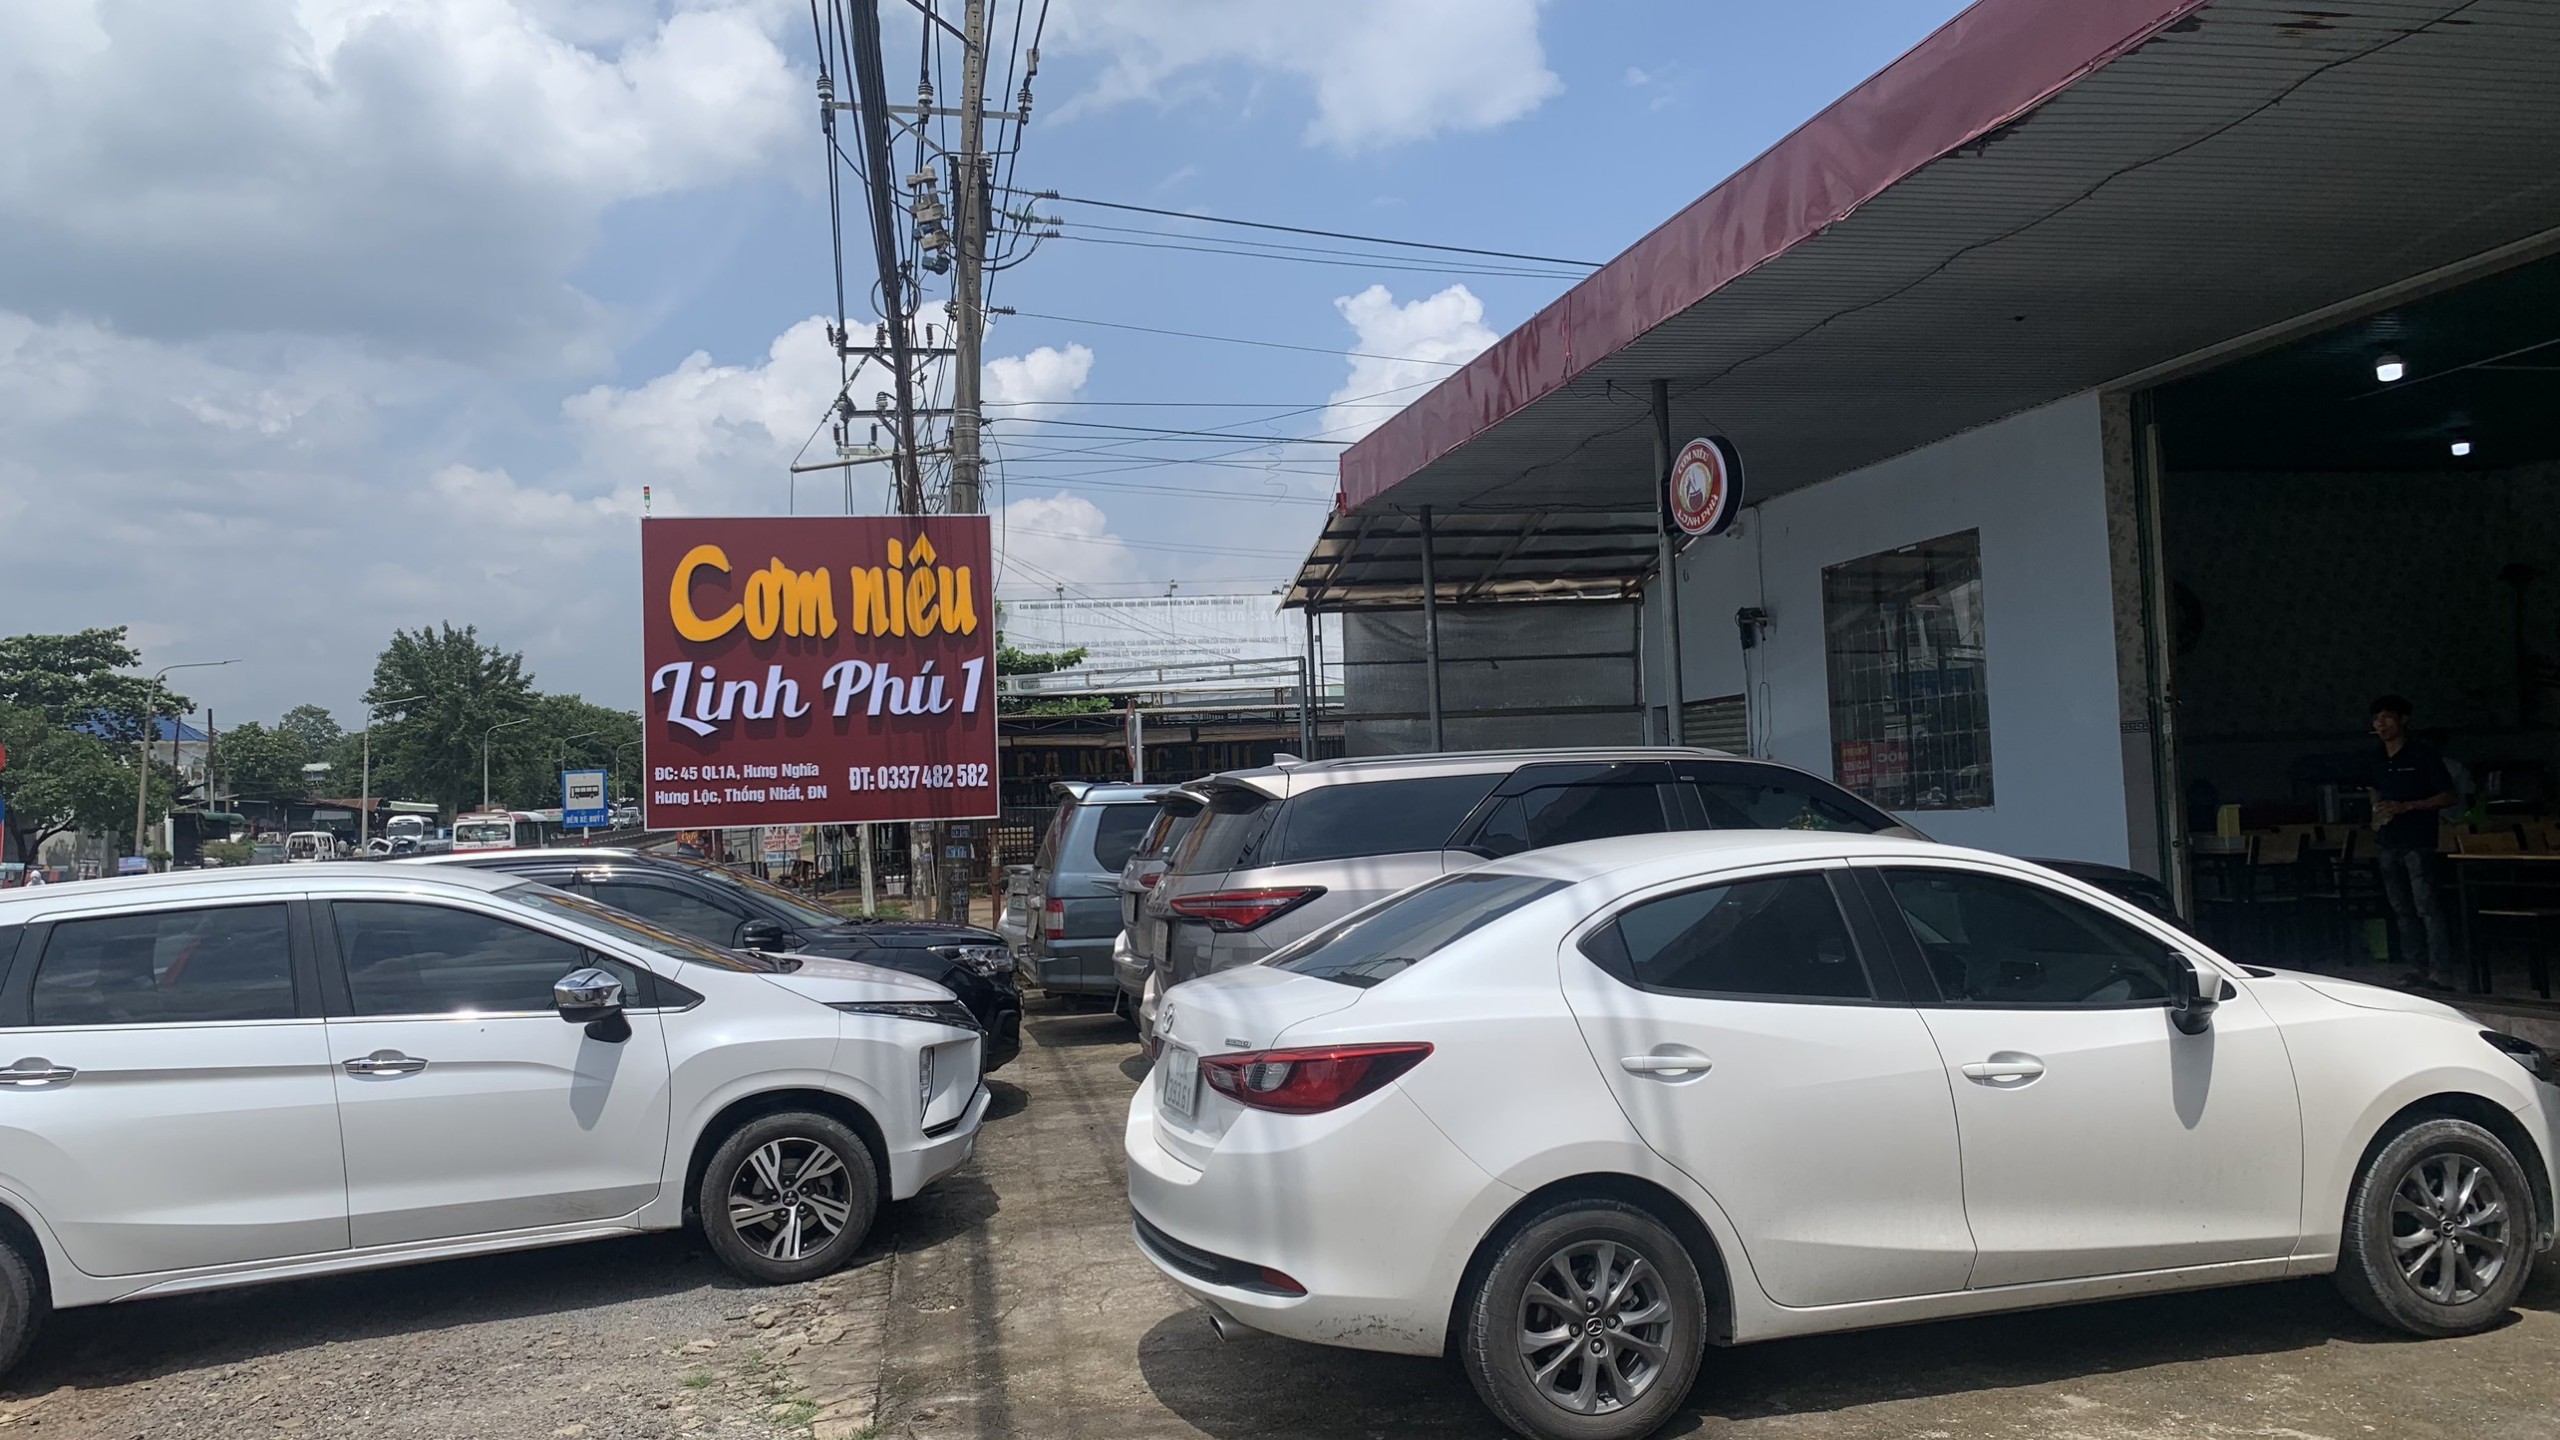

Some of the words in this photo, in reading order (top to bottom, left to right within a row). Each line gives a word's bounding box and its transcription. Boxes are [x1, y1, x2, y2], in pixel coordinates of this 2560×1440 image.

[1677, 452, 1692, 474] CƠM
[1692, 448, 1709, 463] NIÊU
[669, 544, 838, 642] Cơm
[850, 531, 978, 639] niêu
[651, 660, 811, 737] Linh
[822, 658, 954, 718] Phú
[960, 656, 985, 714] 1
[654, 766, 679, 782] ĐC:
[680, 766, 698, 780] 45
[701, 765, 741, 781] QL1A,
[743, 764, 777, 779] Hưng
[781, 763, 820, 779] Nghĩa
[849, 766, 875, 791] ĐT:
[877, 765, 920, 790] 0337
[921, 764, 954, 788] 482
[956, 763, 989, 788] 582
[655, 790, 689, 806] Hưng
[693, 788, 722, 806] Lộc,
[724, 785, 765, 803] Thống
[769, 783, 805, 802] Nhất,
[807, 785, 827, 800] ĐN
[580, 815, 588, 823] XE
